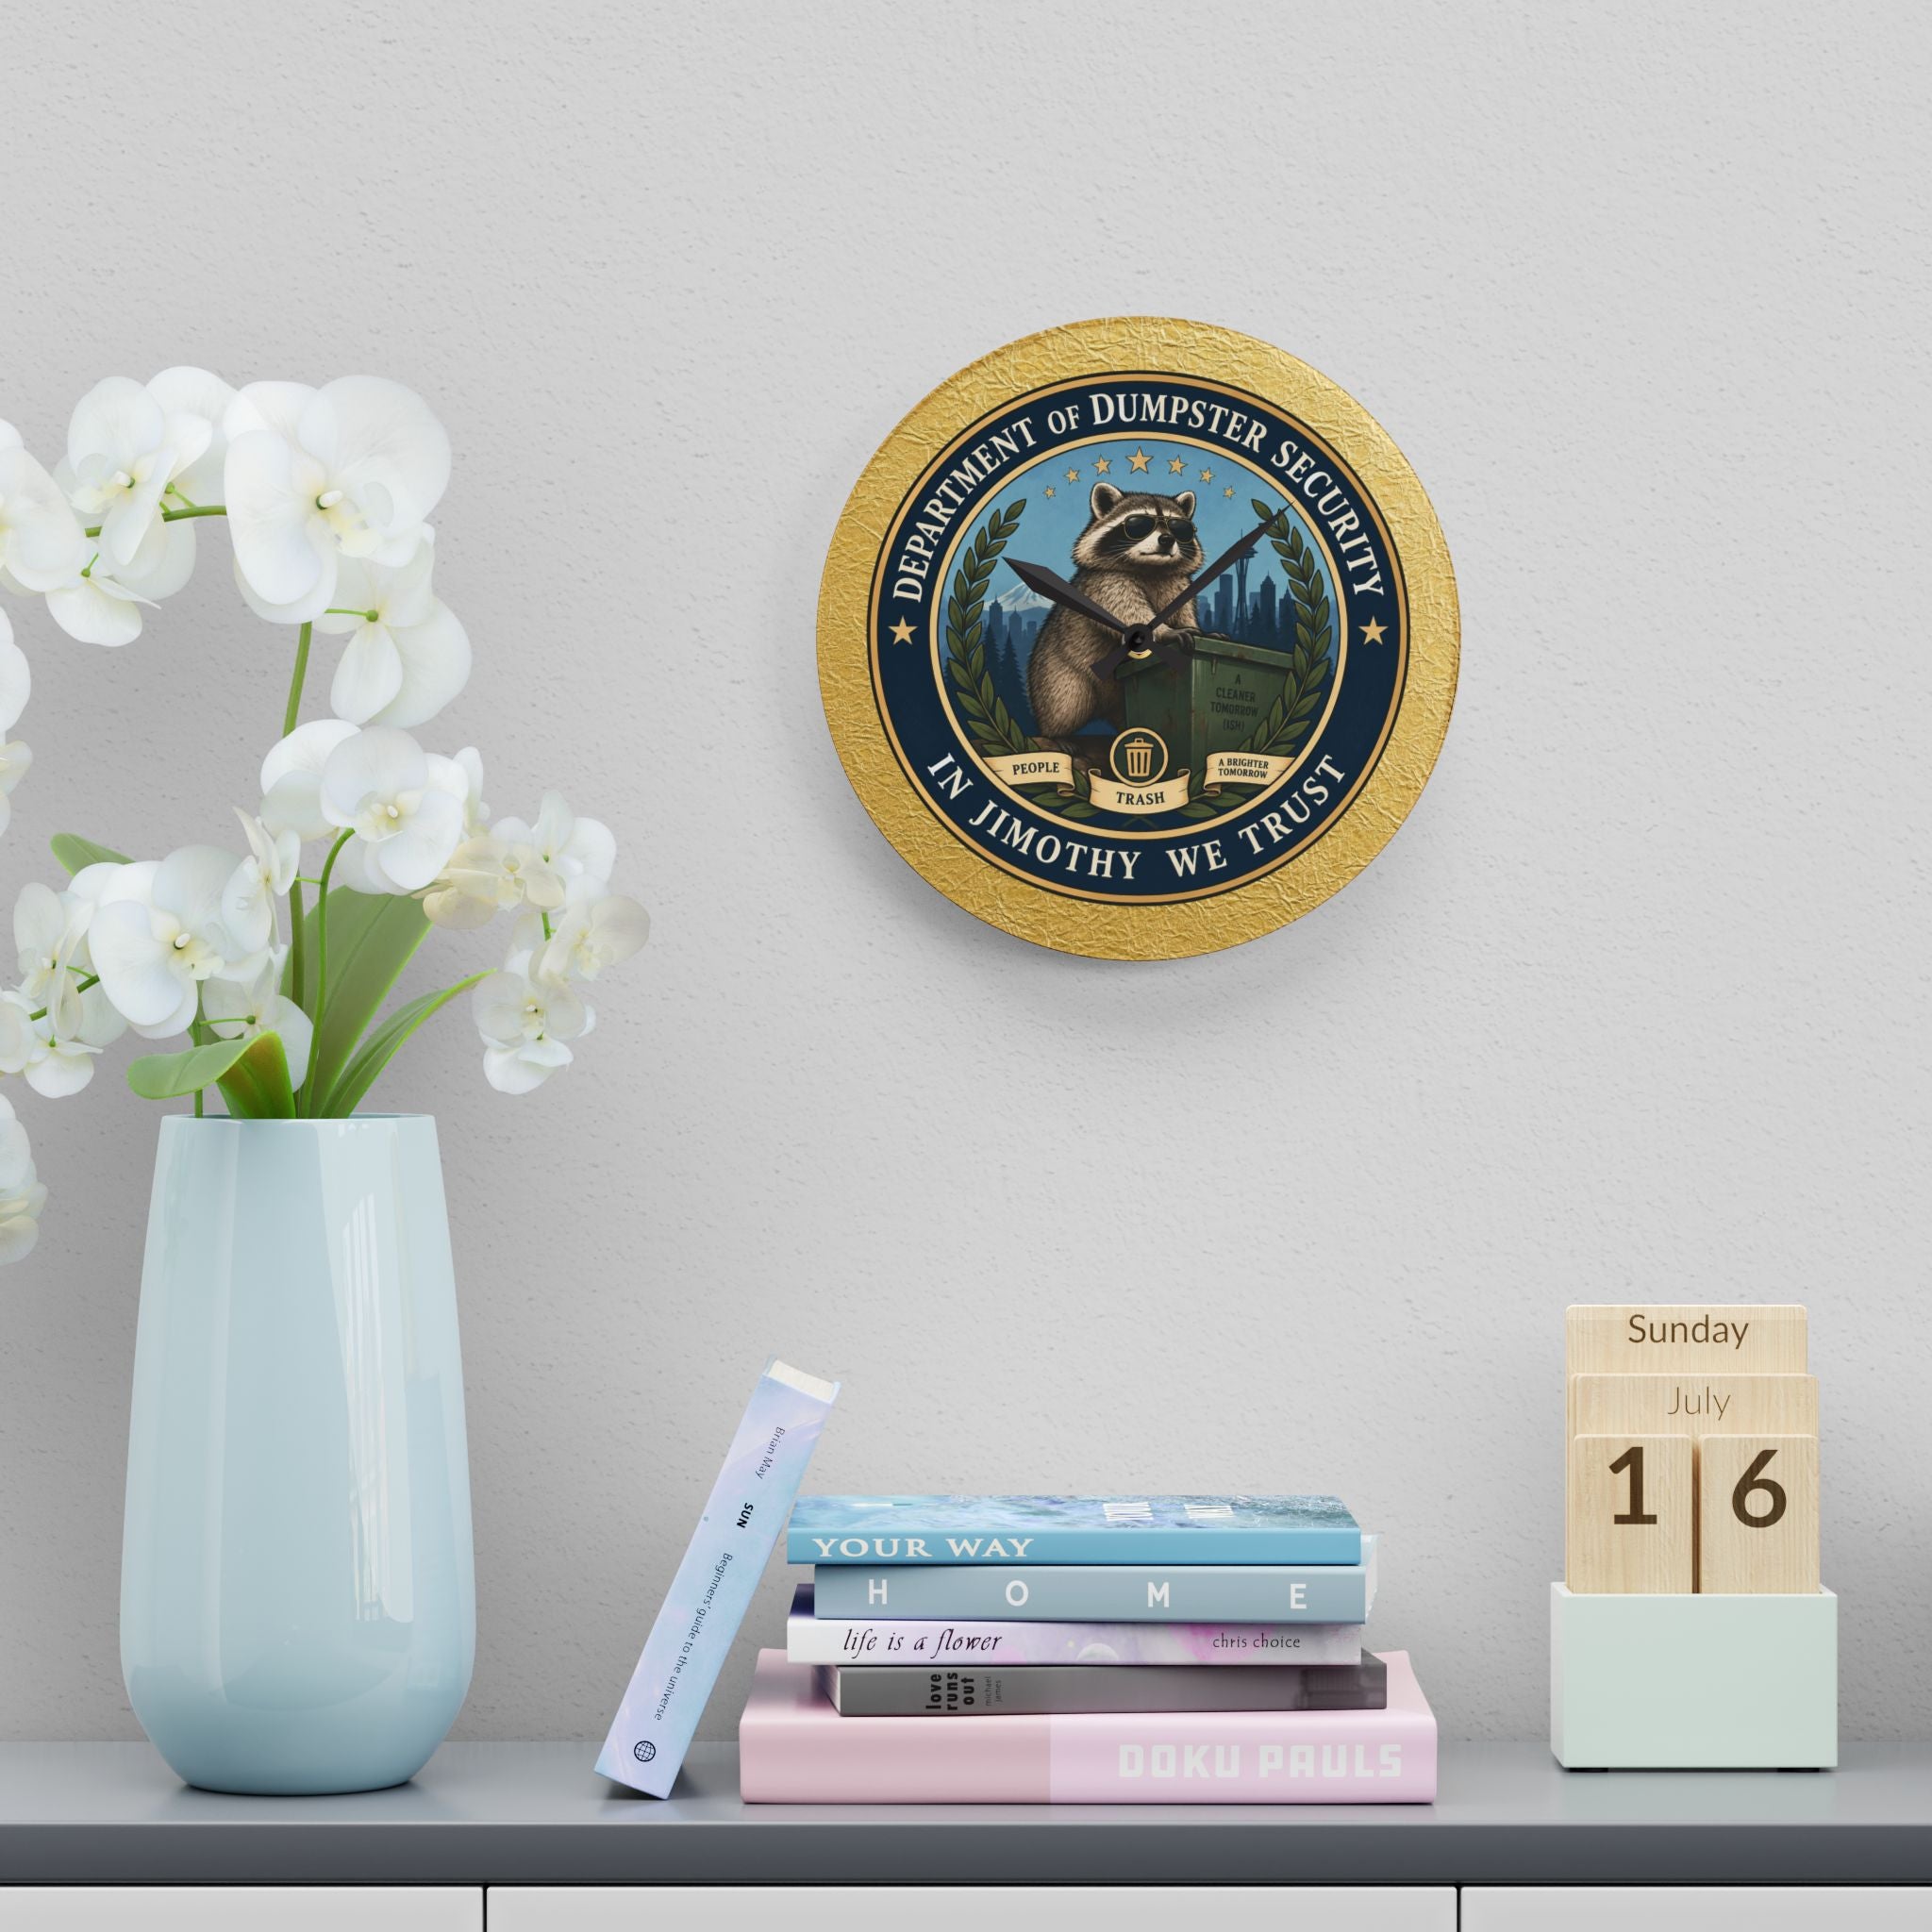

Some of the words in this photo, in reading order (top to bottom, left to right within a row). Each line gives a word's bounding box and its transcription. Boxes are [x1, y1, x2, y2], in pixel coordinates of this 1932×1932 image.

[892, 416, 1037, 603] DEPARTMENT
[1047, 405, 1080, 435] OF
[1089, 392, 1268, 453] DUMPSTER
[1270, 440, 1385, 597] SECURITY
[1234, 674, 1241, 685] A
[1215, 687, 1256, 703] CLEANER
[1210, 701, 1259, 717] TOMORROW
[1223, 718, 1245, 733] (ISH)
[1012, 761, 1060, 775] PEOPLE
[1218, 758, 1225, 767] A
[1227, 758, 1269, 770] BRIGHTER
[1218, 768, 1268, 779] TOMORROW
[1116, 791, 1166, 806] TRASH
[926, 751, 974, 801] IN
[968, 798, 1141, 879] JIMOTHY
[1166, 839, 1227, 877] WE
[1238, 753, 1347, 856] TRUST
[1627, 1313, 1750, 1350] Sunday
[1667, 1386, 1731, 1421] July
[766, 1426, 786, 1455] Brian
[755, 1456, 774, 1480] May
[736, 1502, 754, 1529] SUN
[811, 1538, 933, 1558] YOUR
[945, 1538, 1035, 1558] WAY
[703, 1552, 733, 1609] Beginners'
[688, 1607, 707, 1640] guide
[682, 1641, 693, 1653] to
[843, 1628, 877, 1659] life
[887, 1631, 903, 1652] is
[913, 1635, 926, 1652] a
[930, 1628, 1003, 1659] flower
[1212, 1632, 1248, 1649] chris
[1252, 1632, 1302, 1649] choice
[673, 1655, 688, 1674] the
[654, 1675, 678, 1722] universe
[925, 1674, 941, 1709] love
[946, 1673, 958, 1711] runs
[960, 1676, 974, 1706] out
[1118, 1743, 1241, 1778] DOKU
[1258, 1743, 1403, 1778] PAULS
